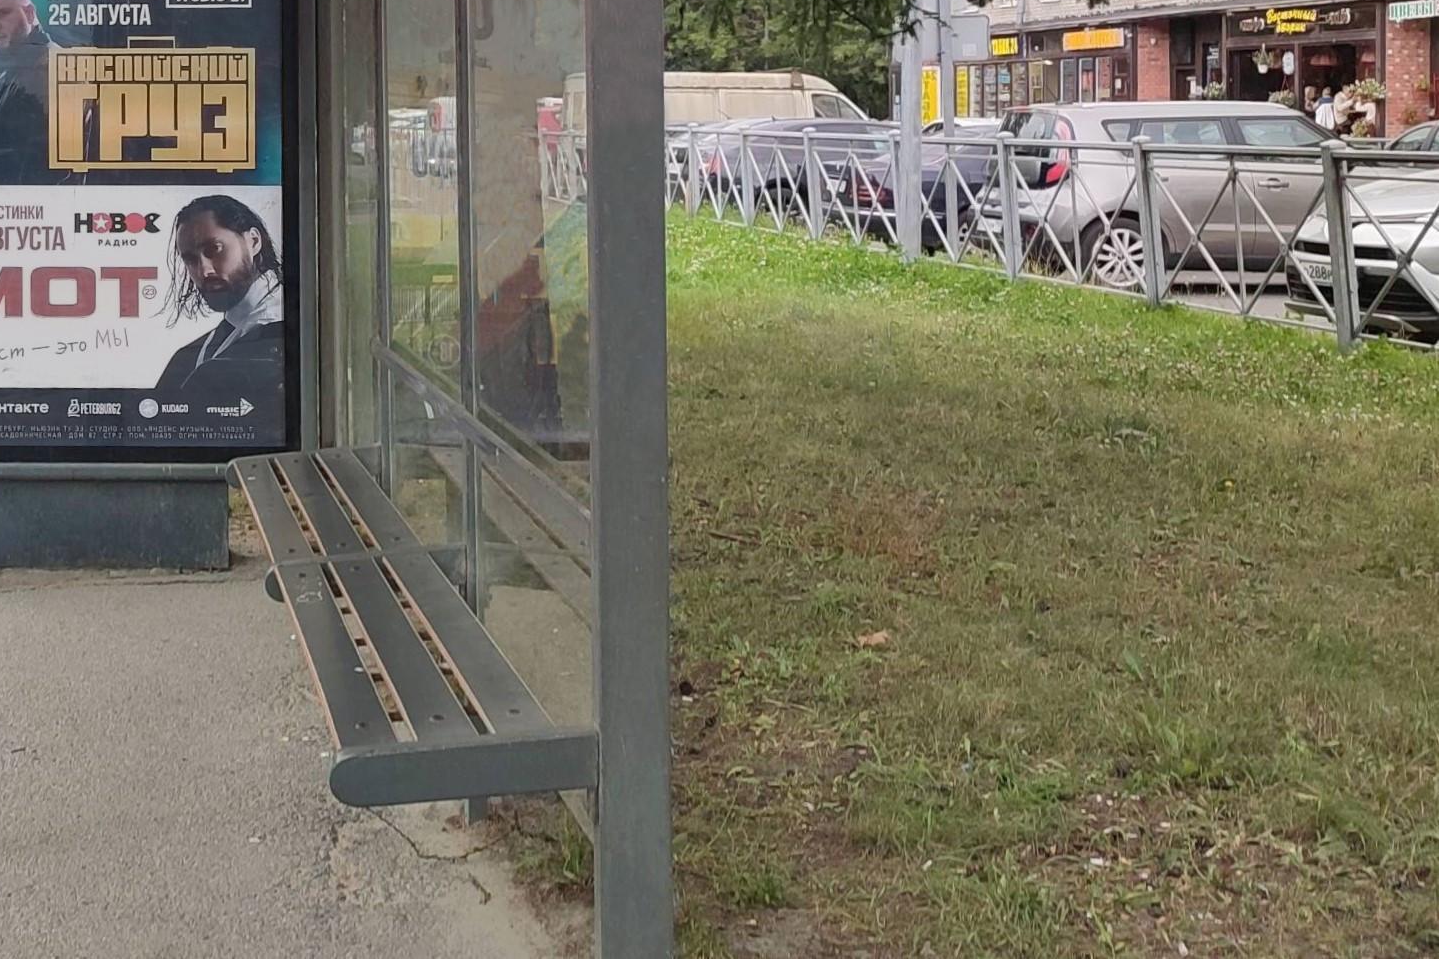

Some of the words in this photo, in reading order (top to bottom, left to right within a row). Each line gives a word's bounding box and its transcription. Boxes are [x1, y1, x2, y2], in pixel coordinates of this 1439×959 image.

[48, 4, 71, 26] 25
[75, 3, 151, 26] АВГУСТА
[58, 54, 248, 82] КАСПИЙСКИЙ
[58, 83, 248, 162] ГРУЗ
[98, 239, 137, 247] РАДИО
[57, 340, 87, 354] это
[162, 404, 189, 413] KUDAGO
